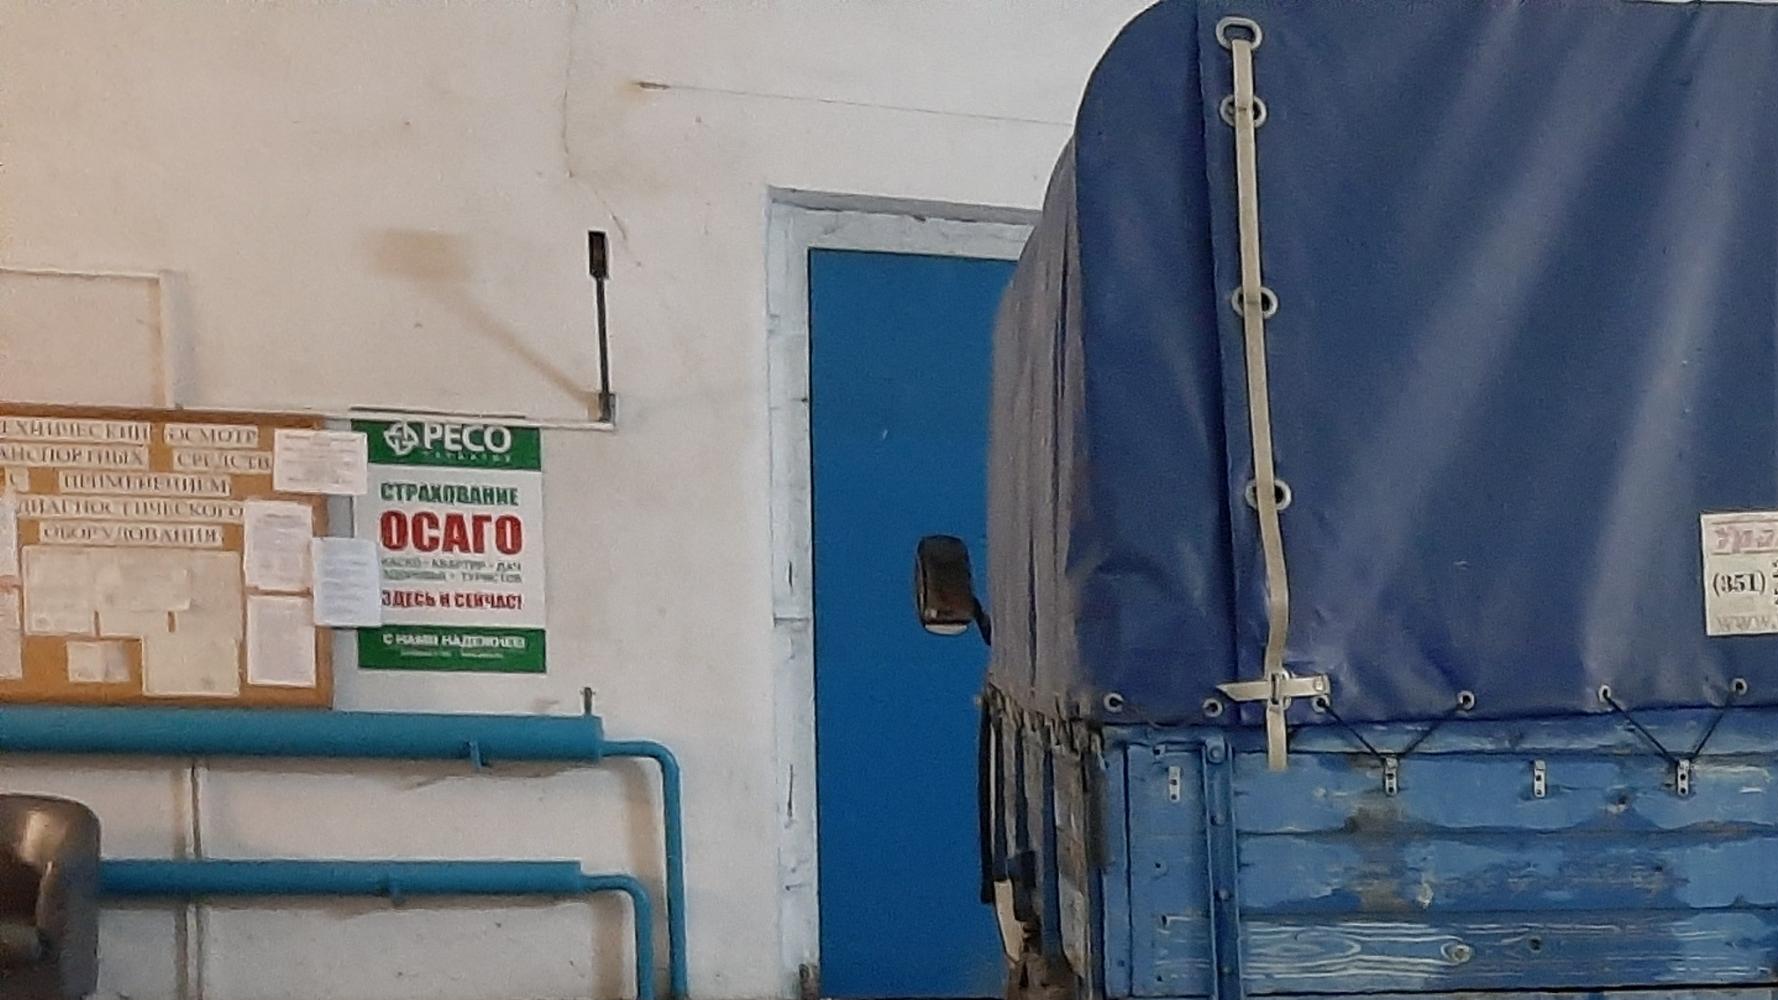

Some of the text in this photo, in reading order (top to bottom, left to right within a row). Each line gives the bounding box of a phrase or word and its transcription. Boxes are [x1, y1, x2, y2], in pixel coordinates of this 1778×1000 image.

[423, 423, 512, 453] РЕСО
[381, 482, 519, 505] СТРАХОВАНИЕ
[380, 510, 523, 555] ОСАГО
[1713, 572, 1766, 598] (351)
[382, 589, 436, 608] ЗДЕСЬ
[440, 591, 450, 608] И
